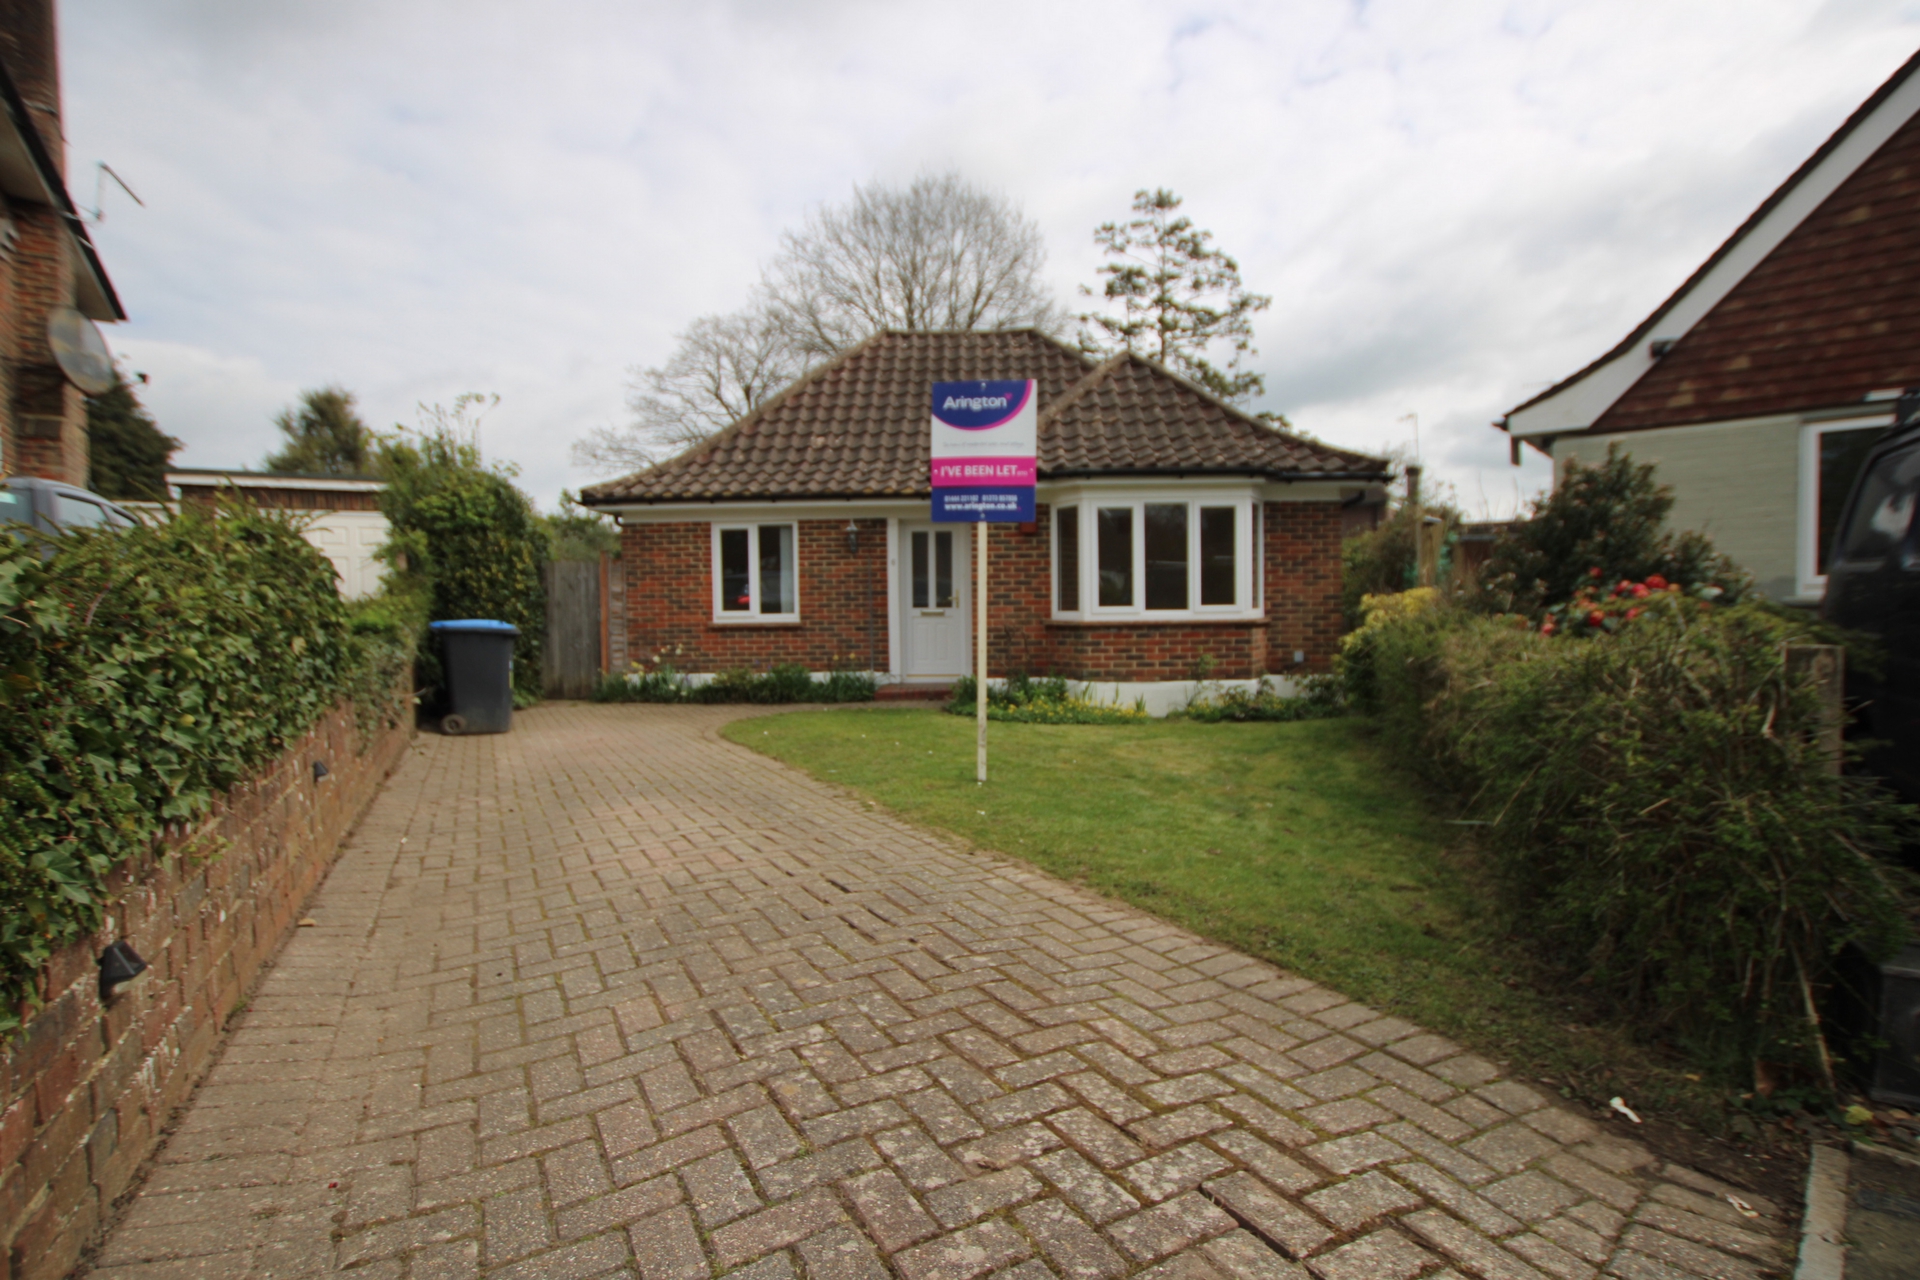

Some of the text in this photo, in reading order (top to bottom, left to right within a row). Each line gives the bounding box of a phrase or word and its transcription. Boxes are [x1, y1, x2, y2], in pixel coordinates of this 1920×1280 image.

[943, 396, 1007, 411] Arington
[940, 465, 962, 477] I'VE
[964, 465, 994, 477] BEEN
